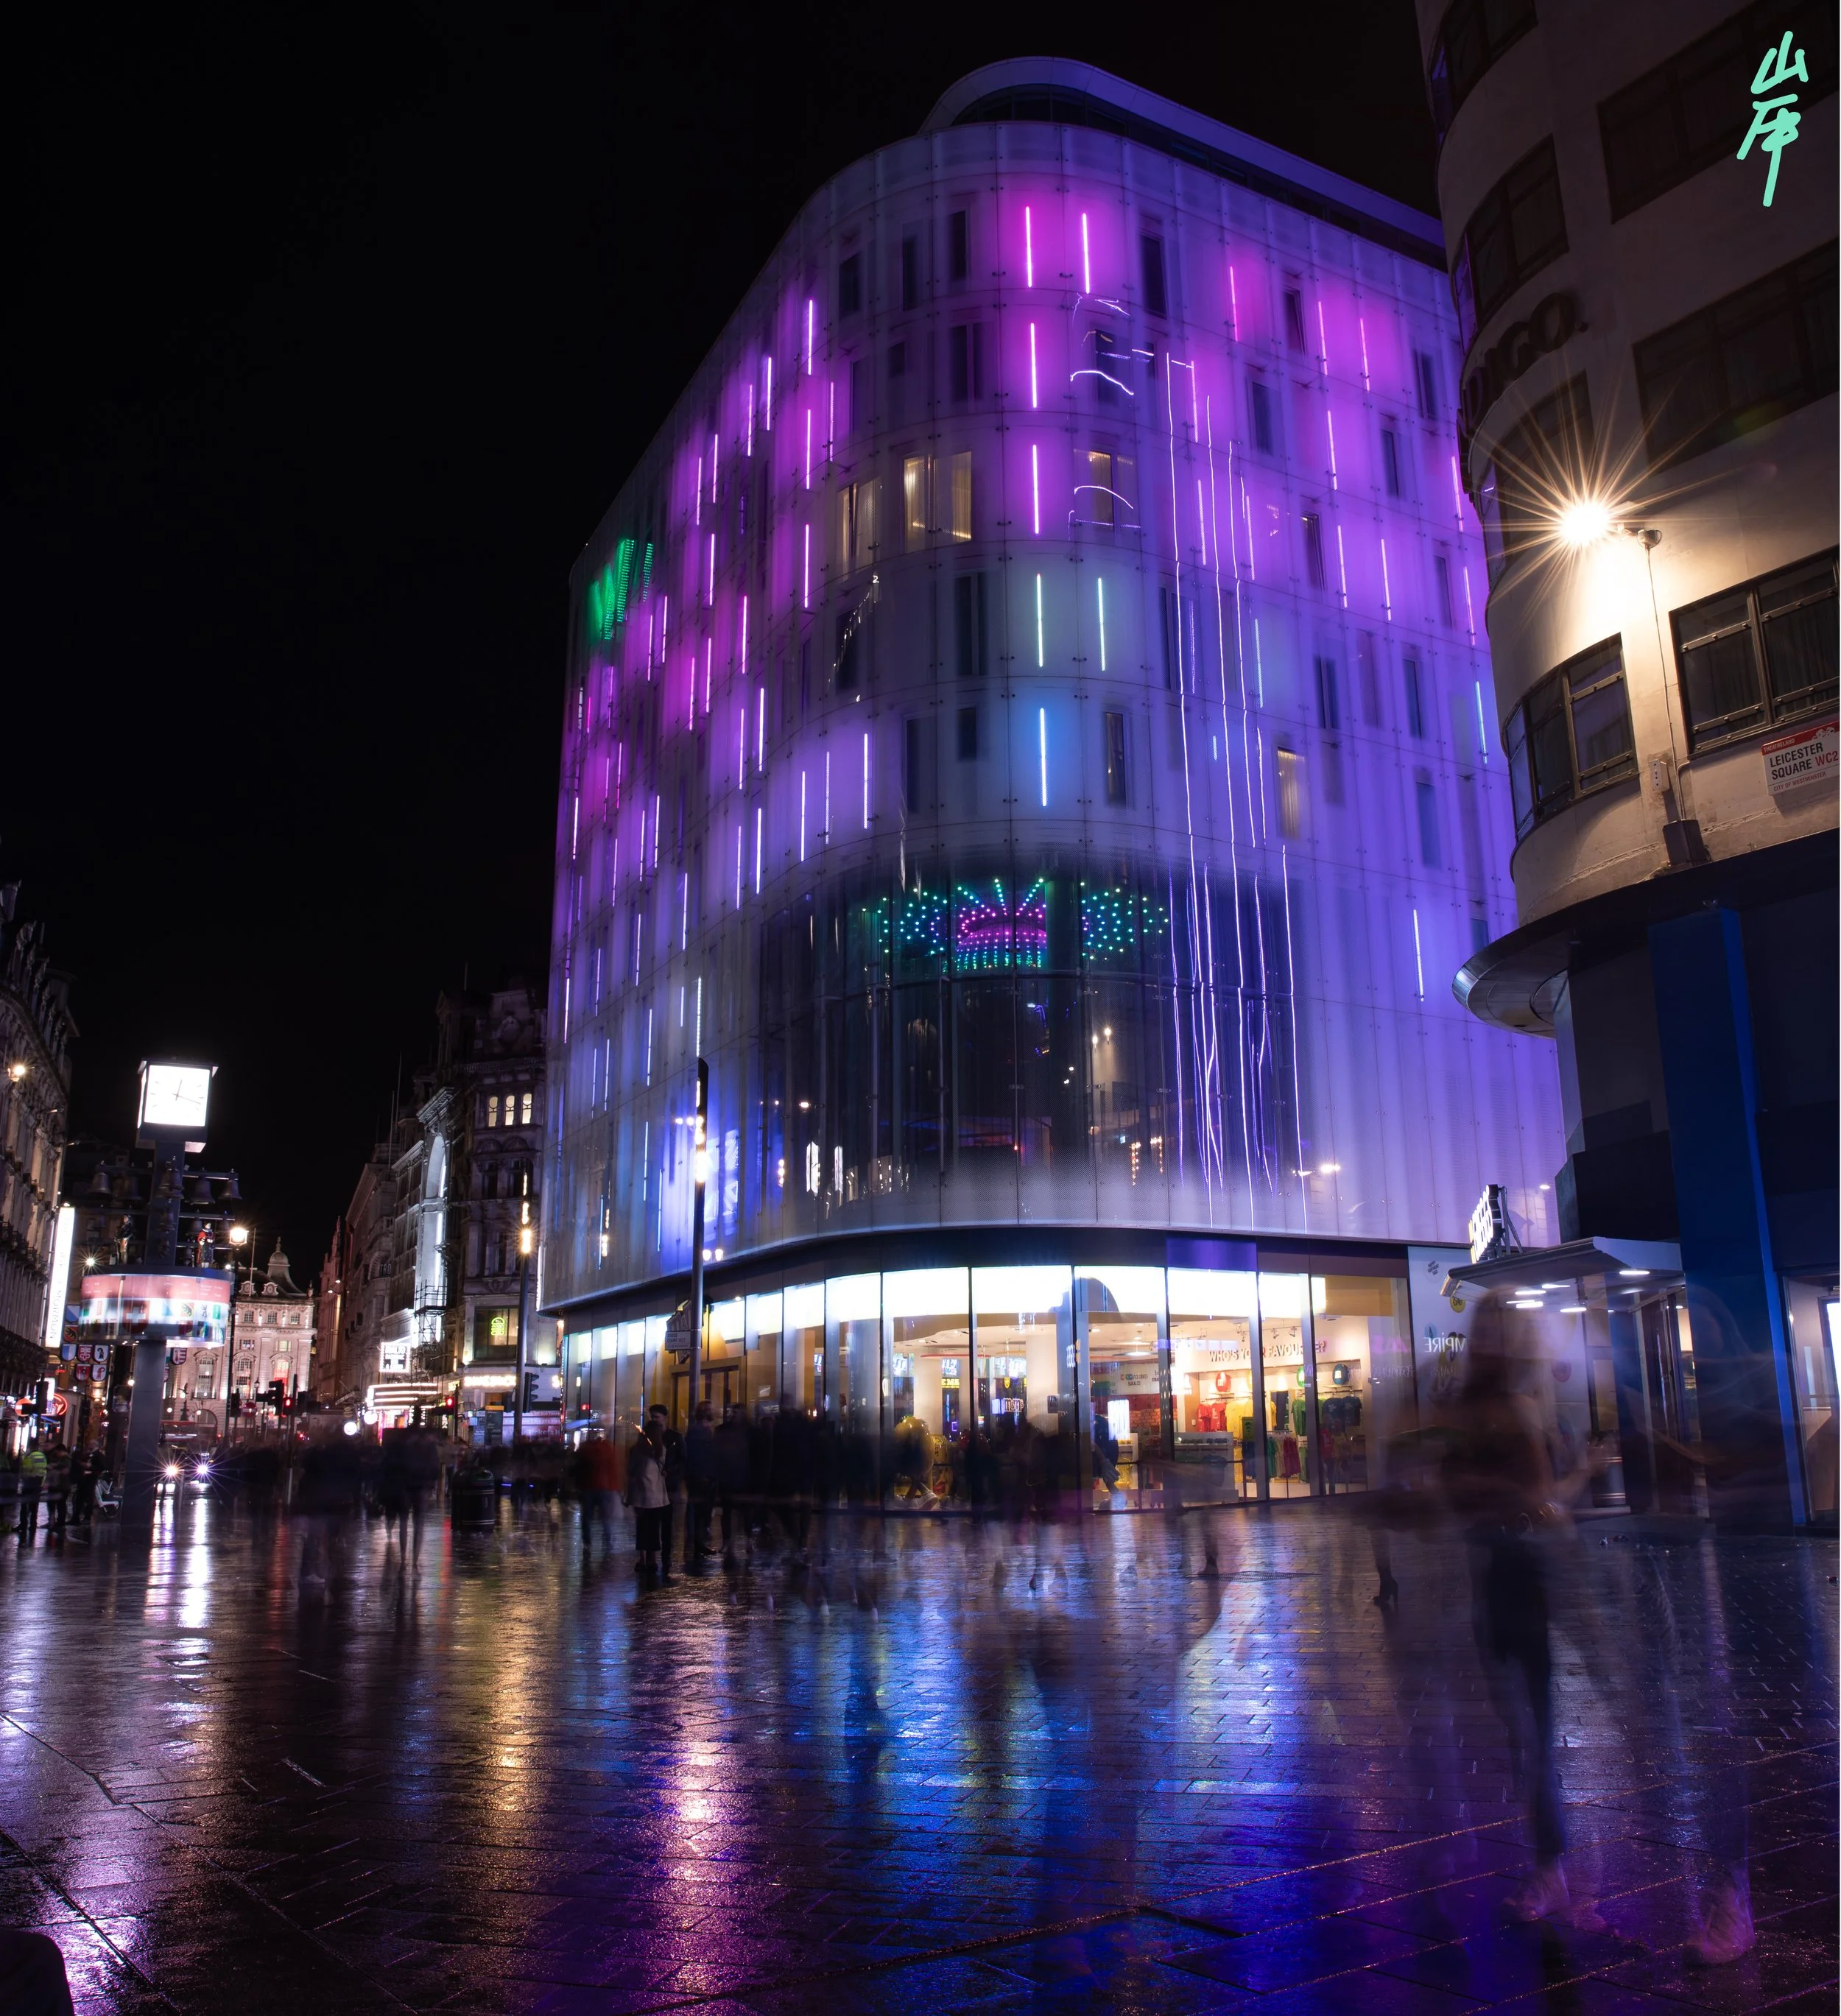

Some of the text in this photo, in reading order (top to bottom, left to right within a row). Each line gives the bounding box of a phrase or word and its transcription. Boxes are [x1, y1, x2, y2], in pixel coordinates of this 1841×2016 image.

[1763, 739, 1795, 753] THEATRELAND
[1770, 742, 1823, 767] LEICESTER
[1771, 750, 1839, 780] SQUARE WC2
[1773, 783, 1784, 792] CITY
[1792, 772, 1826, 786] WESTMINSTER
[1242, 1346, 1266, 1360] YOR
